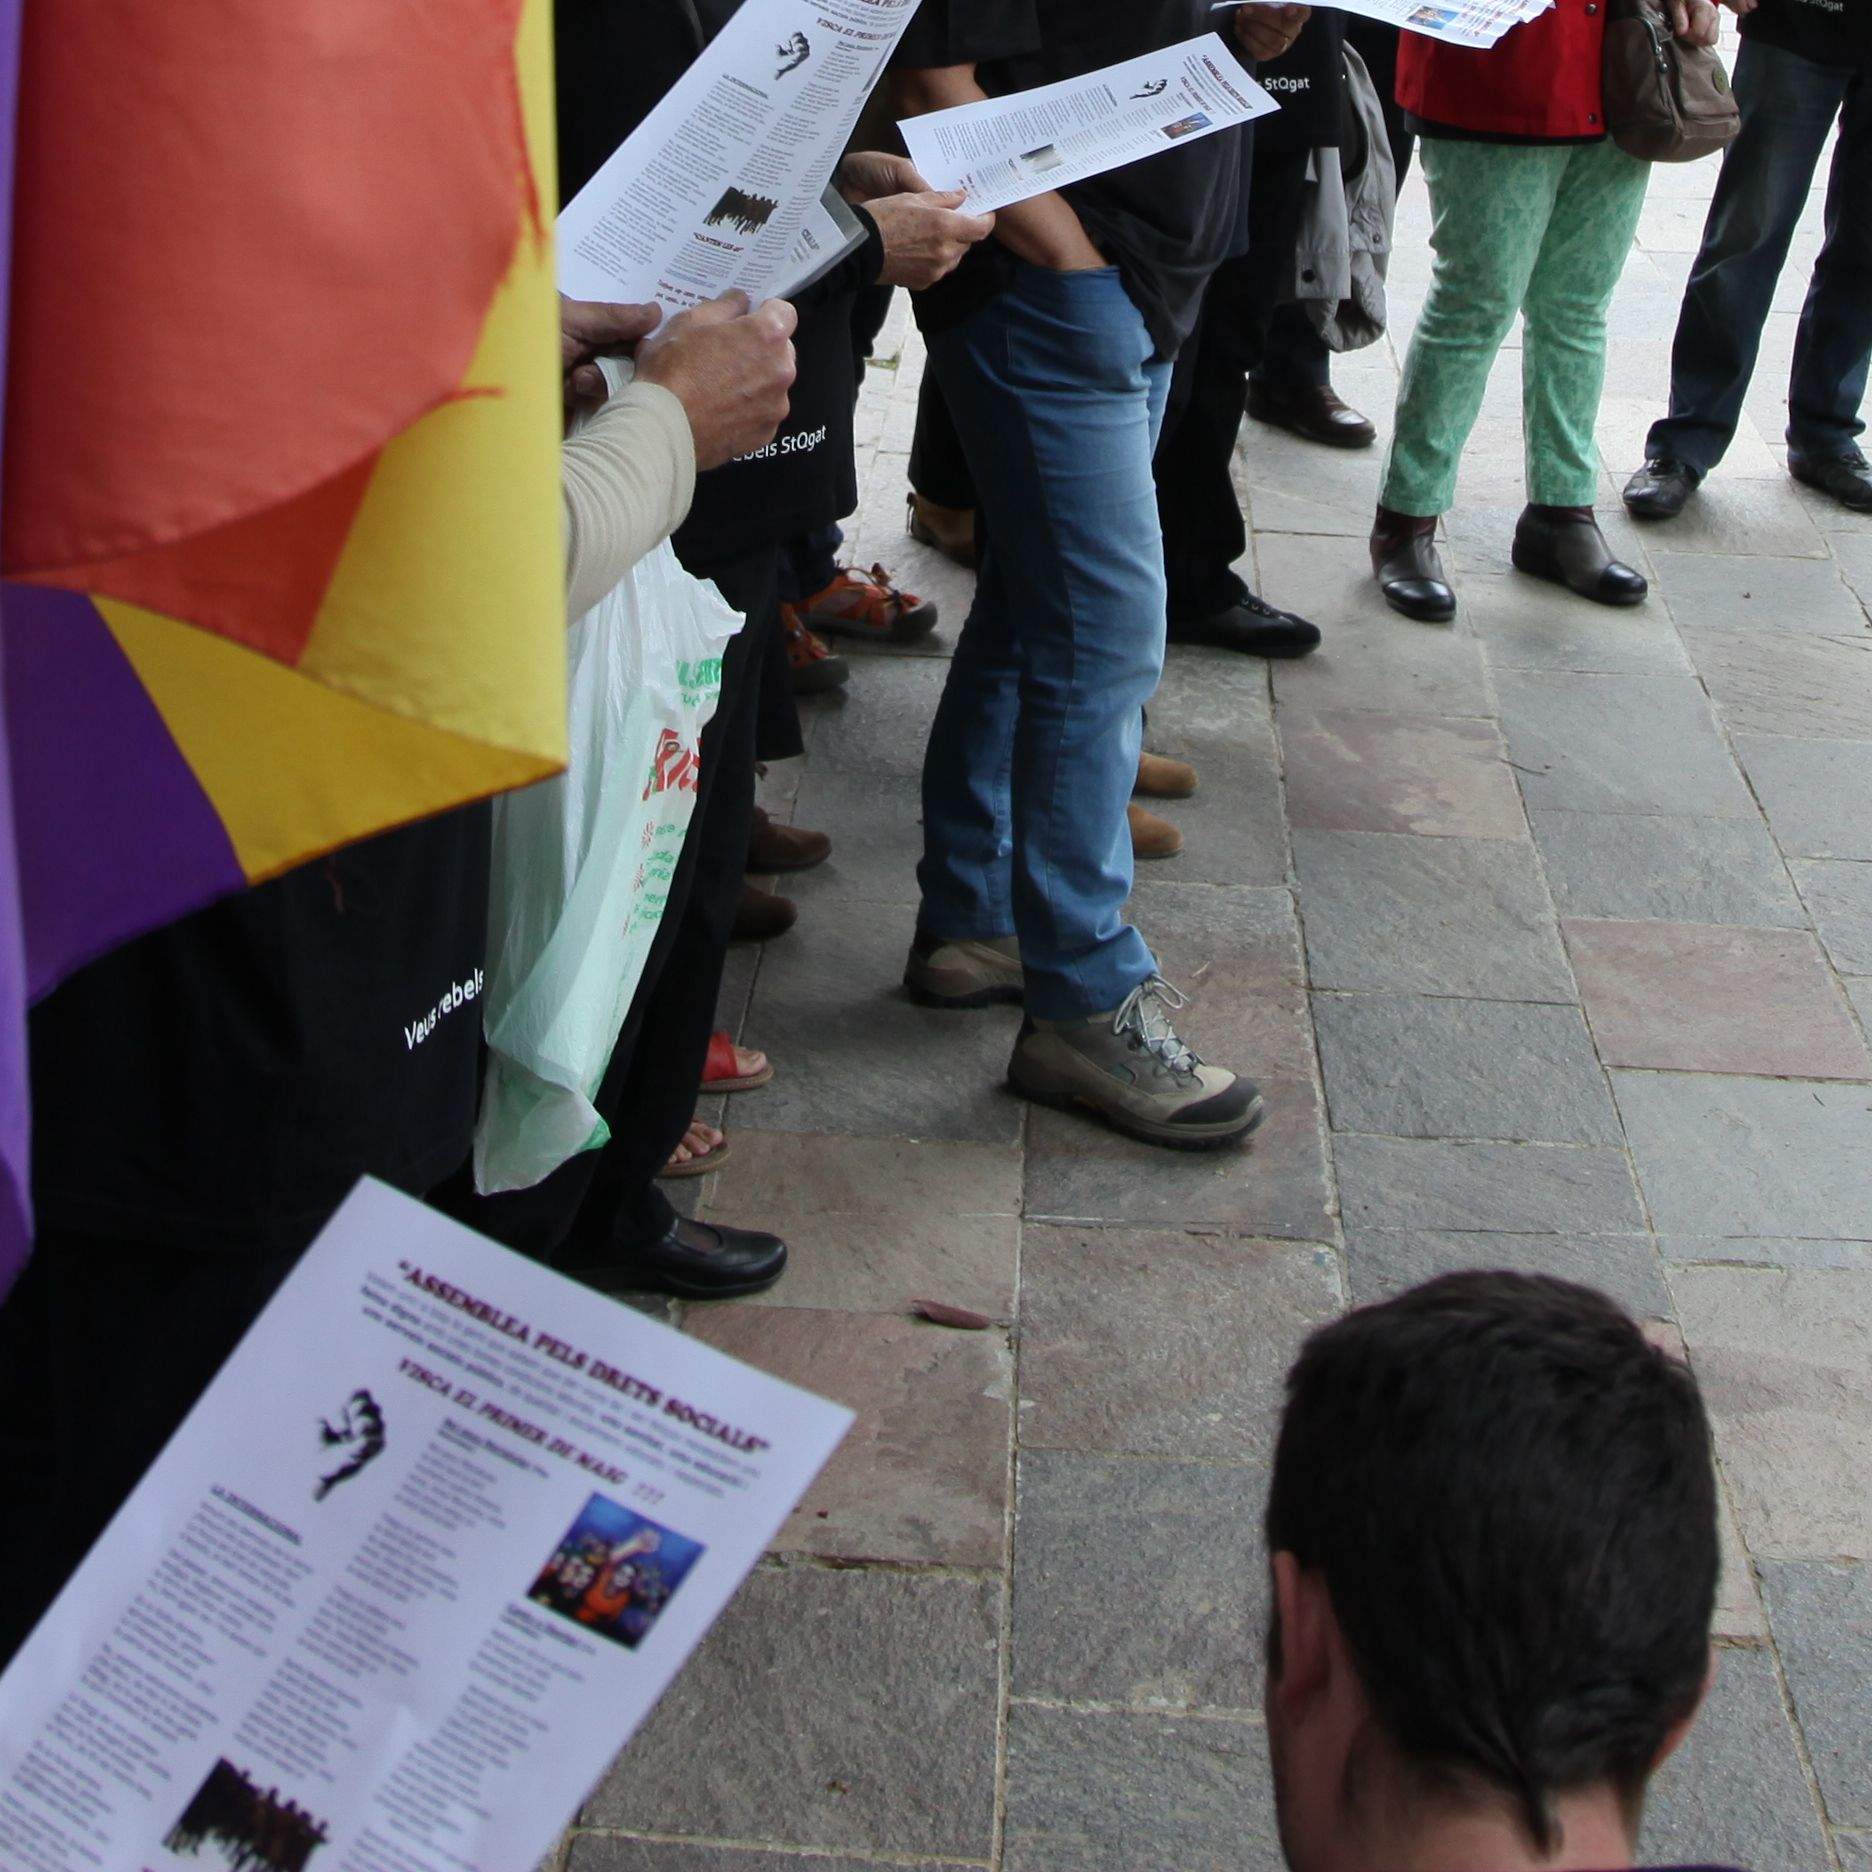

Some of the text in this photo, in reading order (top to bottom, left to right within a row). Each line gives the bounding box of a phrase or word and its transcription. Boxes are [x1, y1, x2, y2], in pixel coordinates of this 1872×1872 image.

[403, 967, 484, 1050] Veus rebels
[398, 1356, 453, 1398] VISCA
[478, 1400, 550, 1446] PRIMER
[532, 1330, 590, 1372] PELS
[587, 1358, 664, 1409] DRETS
